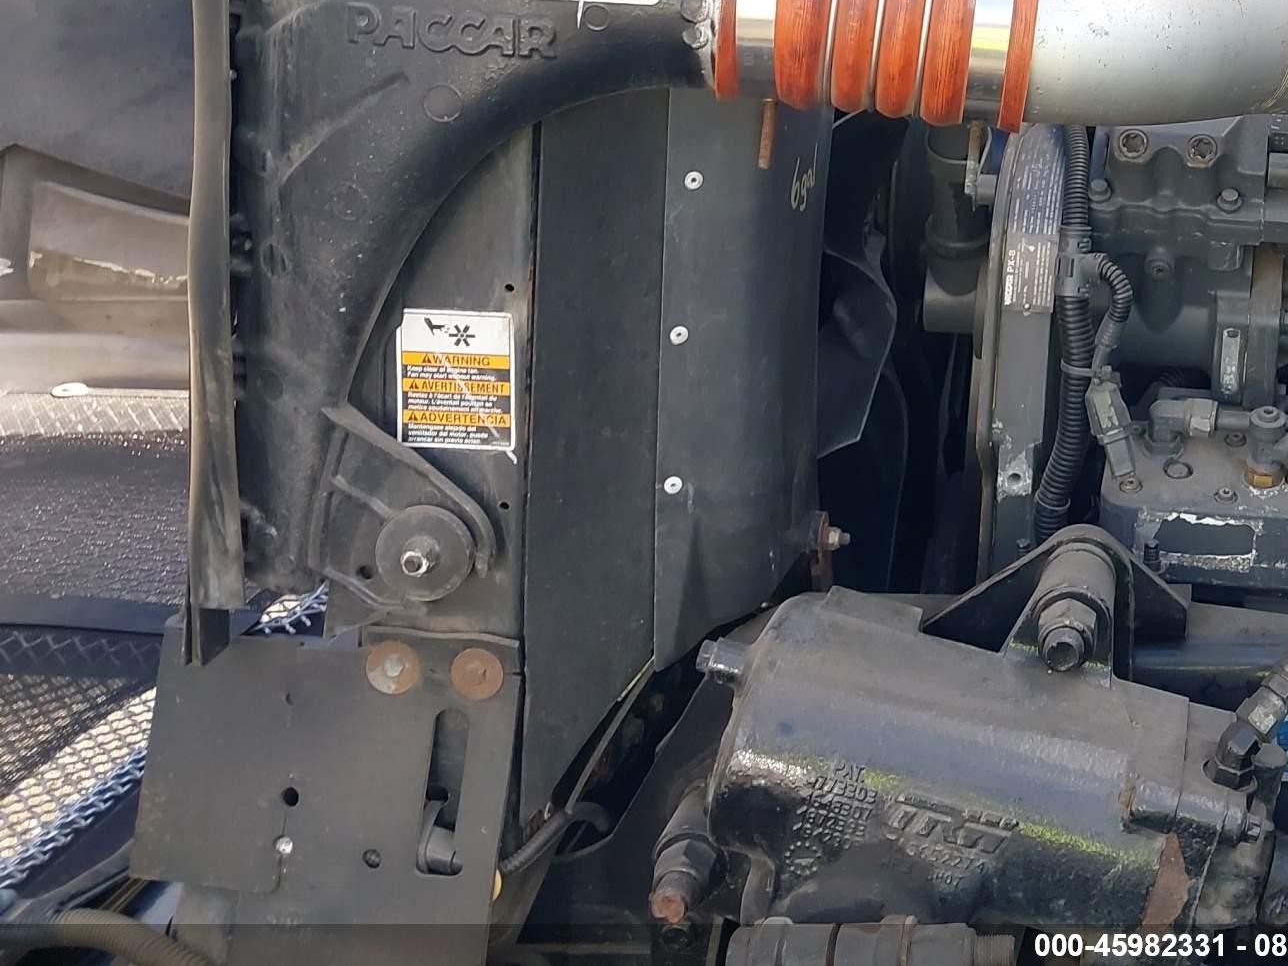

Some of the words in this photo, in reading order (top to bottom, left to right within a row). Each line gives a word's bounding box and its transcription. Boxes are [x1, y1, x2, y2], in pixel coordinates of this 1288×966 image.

[347, 2, 558, 58] PACCAR
[432, 355, 491, 366] WARNING
[421, 380, 505, 394] AVERTISSEMENT
[420, 412, 507, 427] ADVERTENCIA
